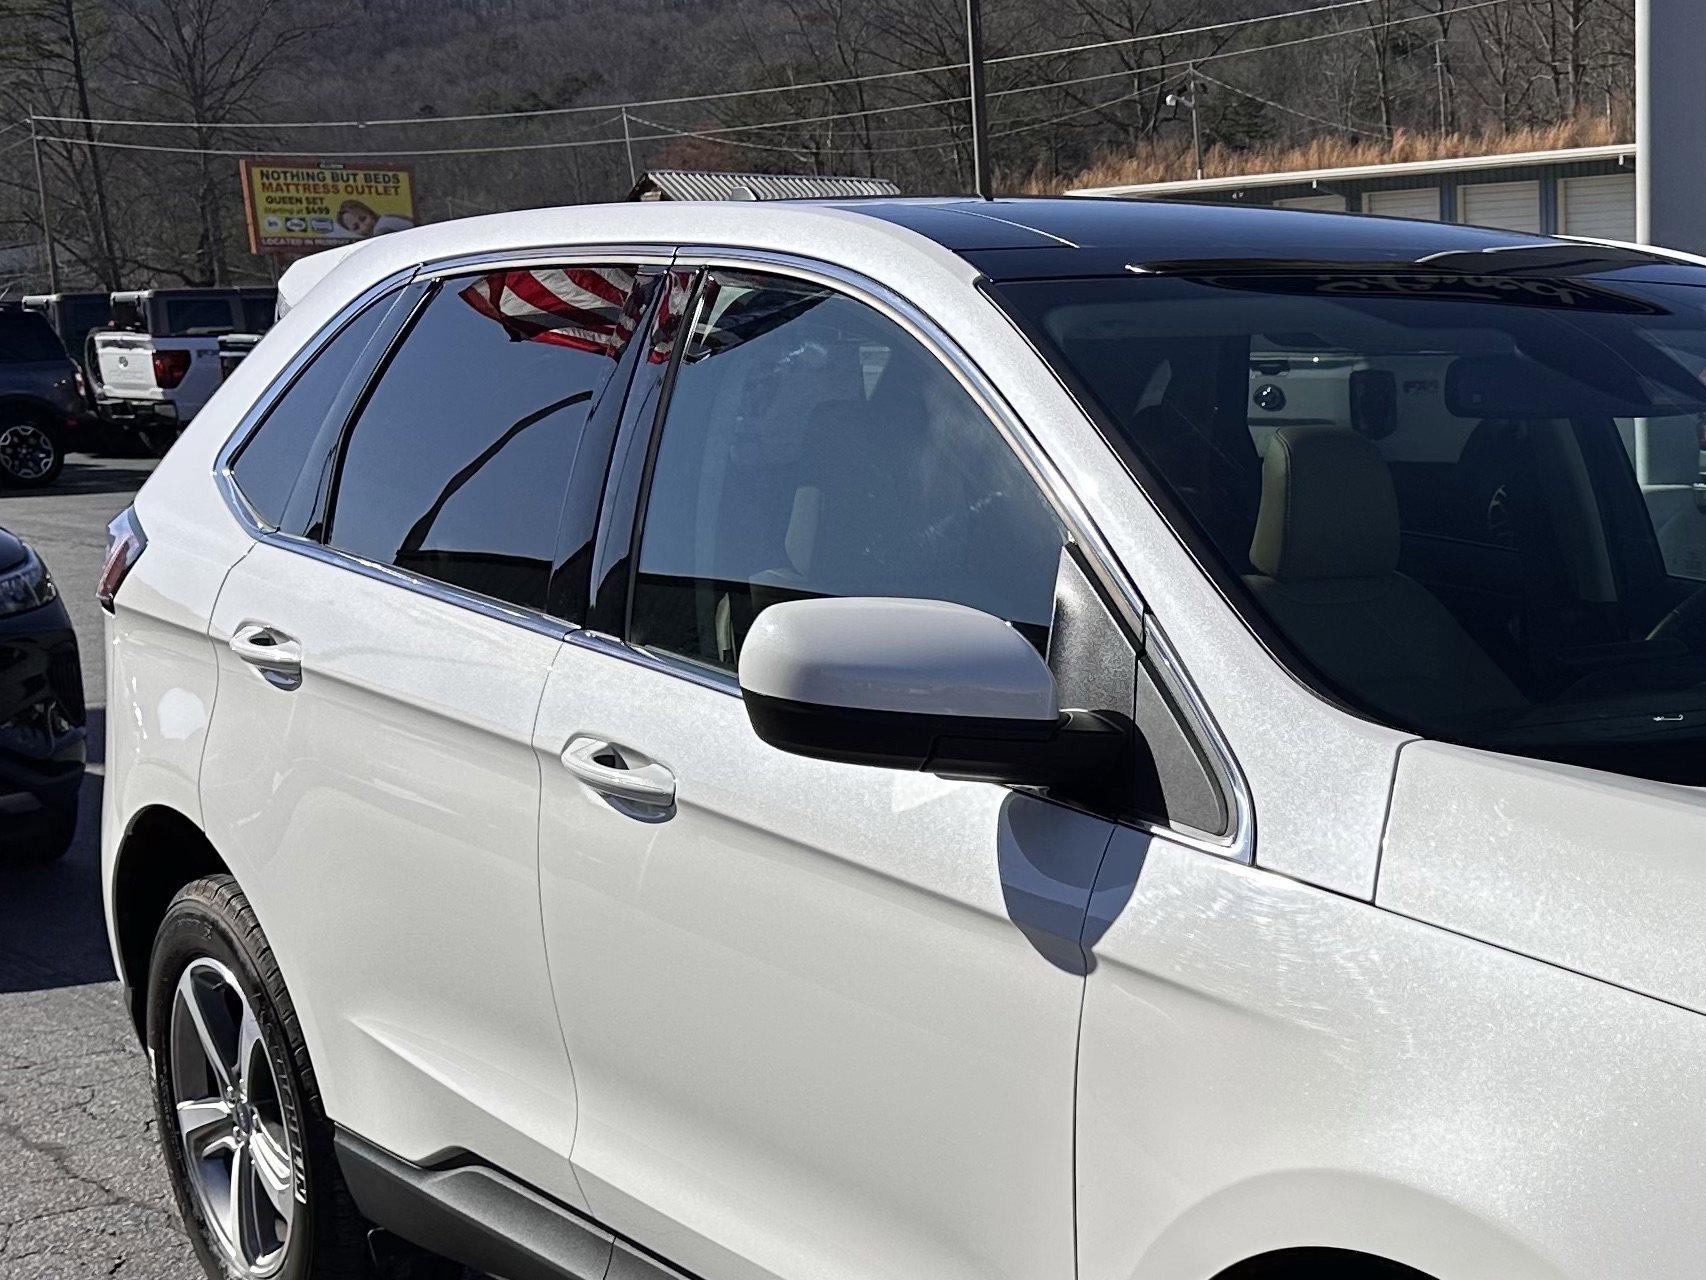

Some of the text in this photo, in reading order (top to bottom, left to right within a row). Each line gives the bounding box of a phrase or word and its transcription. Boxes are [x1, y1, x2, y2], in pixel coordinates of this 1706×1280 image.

[260, 170, 400, 184] NOTHING BUT BEDS
[261, 182, 400, 196] MATTRESS OUTLET
[265, 196, 324, 205] QUEEN SET
[262, 238, 303, 246] LOCATED
